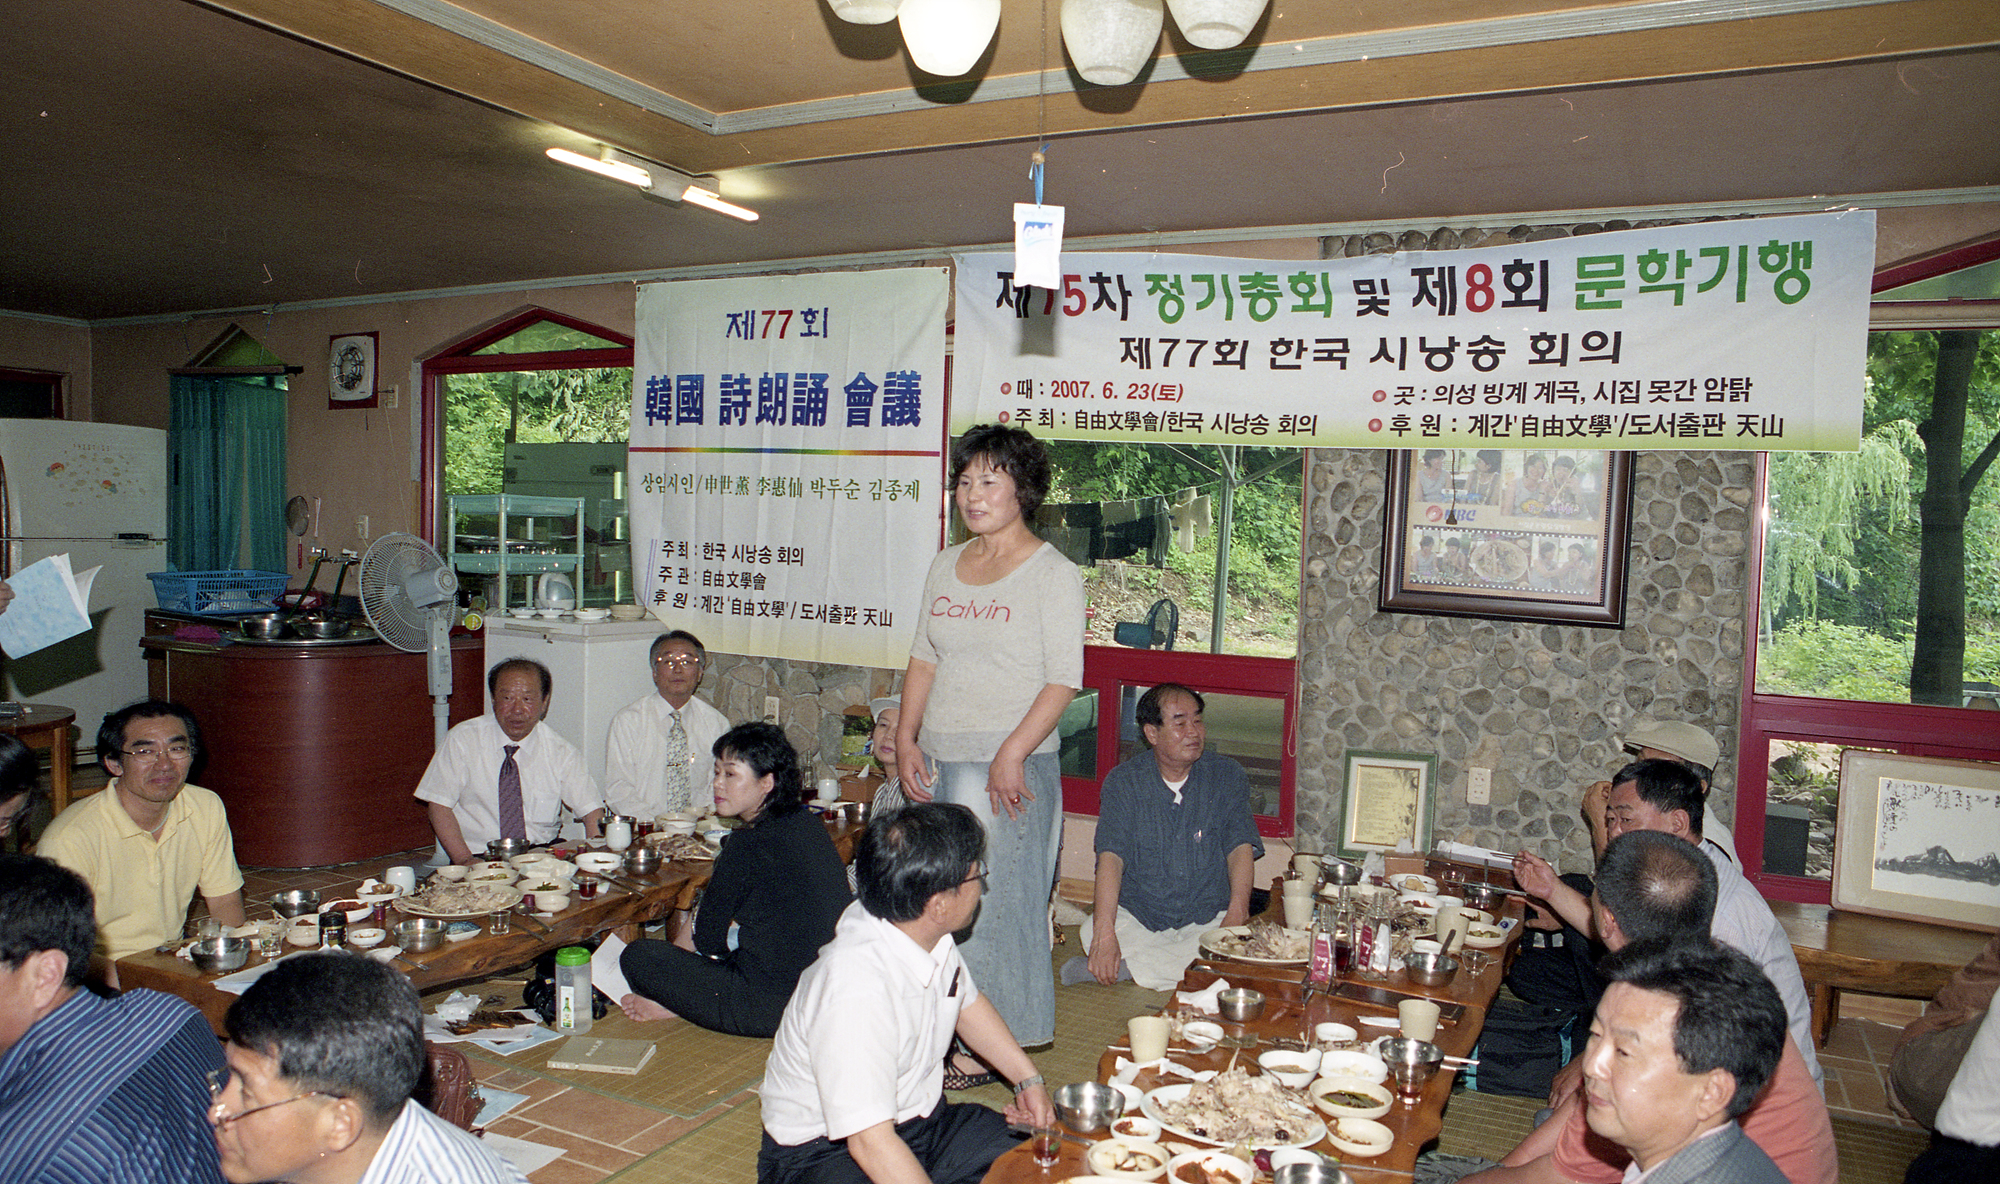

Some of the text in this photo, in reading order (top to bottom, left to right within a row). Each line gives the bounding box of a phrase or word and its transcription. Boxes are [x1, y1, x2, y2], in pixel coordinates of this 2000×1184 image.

[1144, 270, 1334, 325] 정기총회
[1352, 278, 1391, 318] 및
[1410, 257, 1550, 317] 제8회
[1574, 239, 1813, 311] 문학기행
[725, 306, 829, 341] 제77회
[1119, 330, 1623, 373] 제77회 한국 시낭송 회의
[644, 369, 922, 428] 韓國 詩朗誦 會議
[1016, 378, 1034, 400] 때
[1126, 382, 1184, 404] 23(토)
[1393, 386, 1416, 407] 곳
[1432, 383, 1477, 406] 의성
[1483, 381, 1528, 405] 빙계
[1592, 379, 1641, 405] 시집
[1647, 378, 1698, 404] 못간
[1703, 376, 1754, 403] 암탉
[1210, 412, 1270, 436] 시낭송
[1277, 414, 1318, 437] 회의
[1735, 413, 1784, 438] 天山
[756, 476, 803, 499] 李惠仙
[810, 476, 861, 501] 박두순
[868, 478, 920, 503] 김종제
[702, 542, 727, 562] 한국
[731, 543, 773, 565] 시낭송
[776, 546, 804, 567] 회의
[702, 568, 767, 591] 自由文學會
[862, 607, 893, 628] 天山
[931, 596, 1010, 622] Calvin
